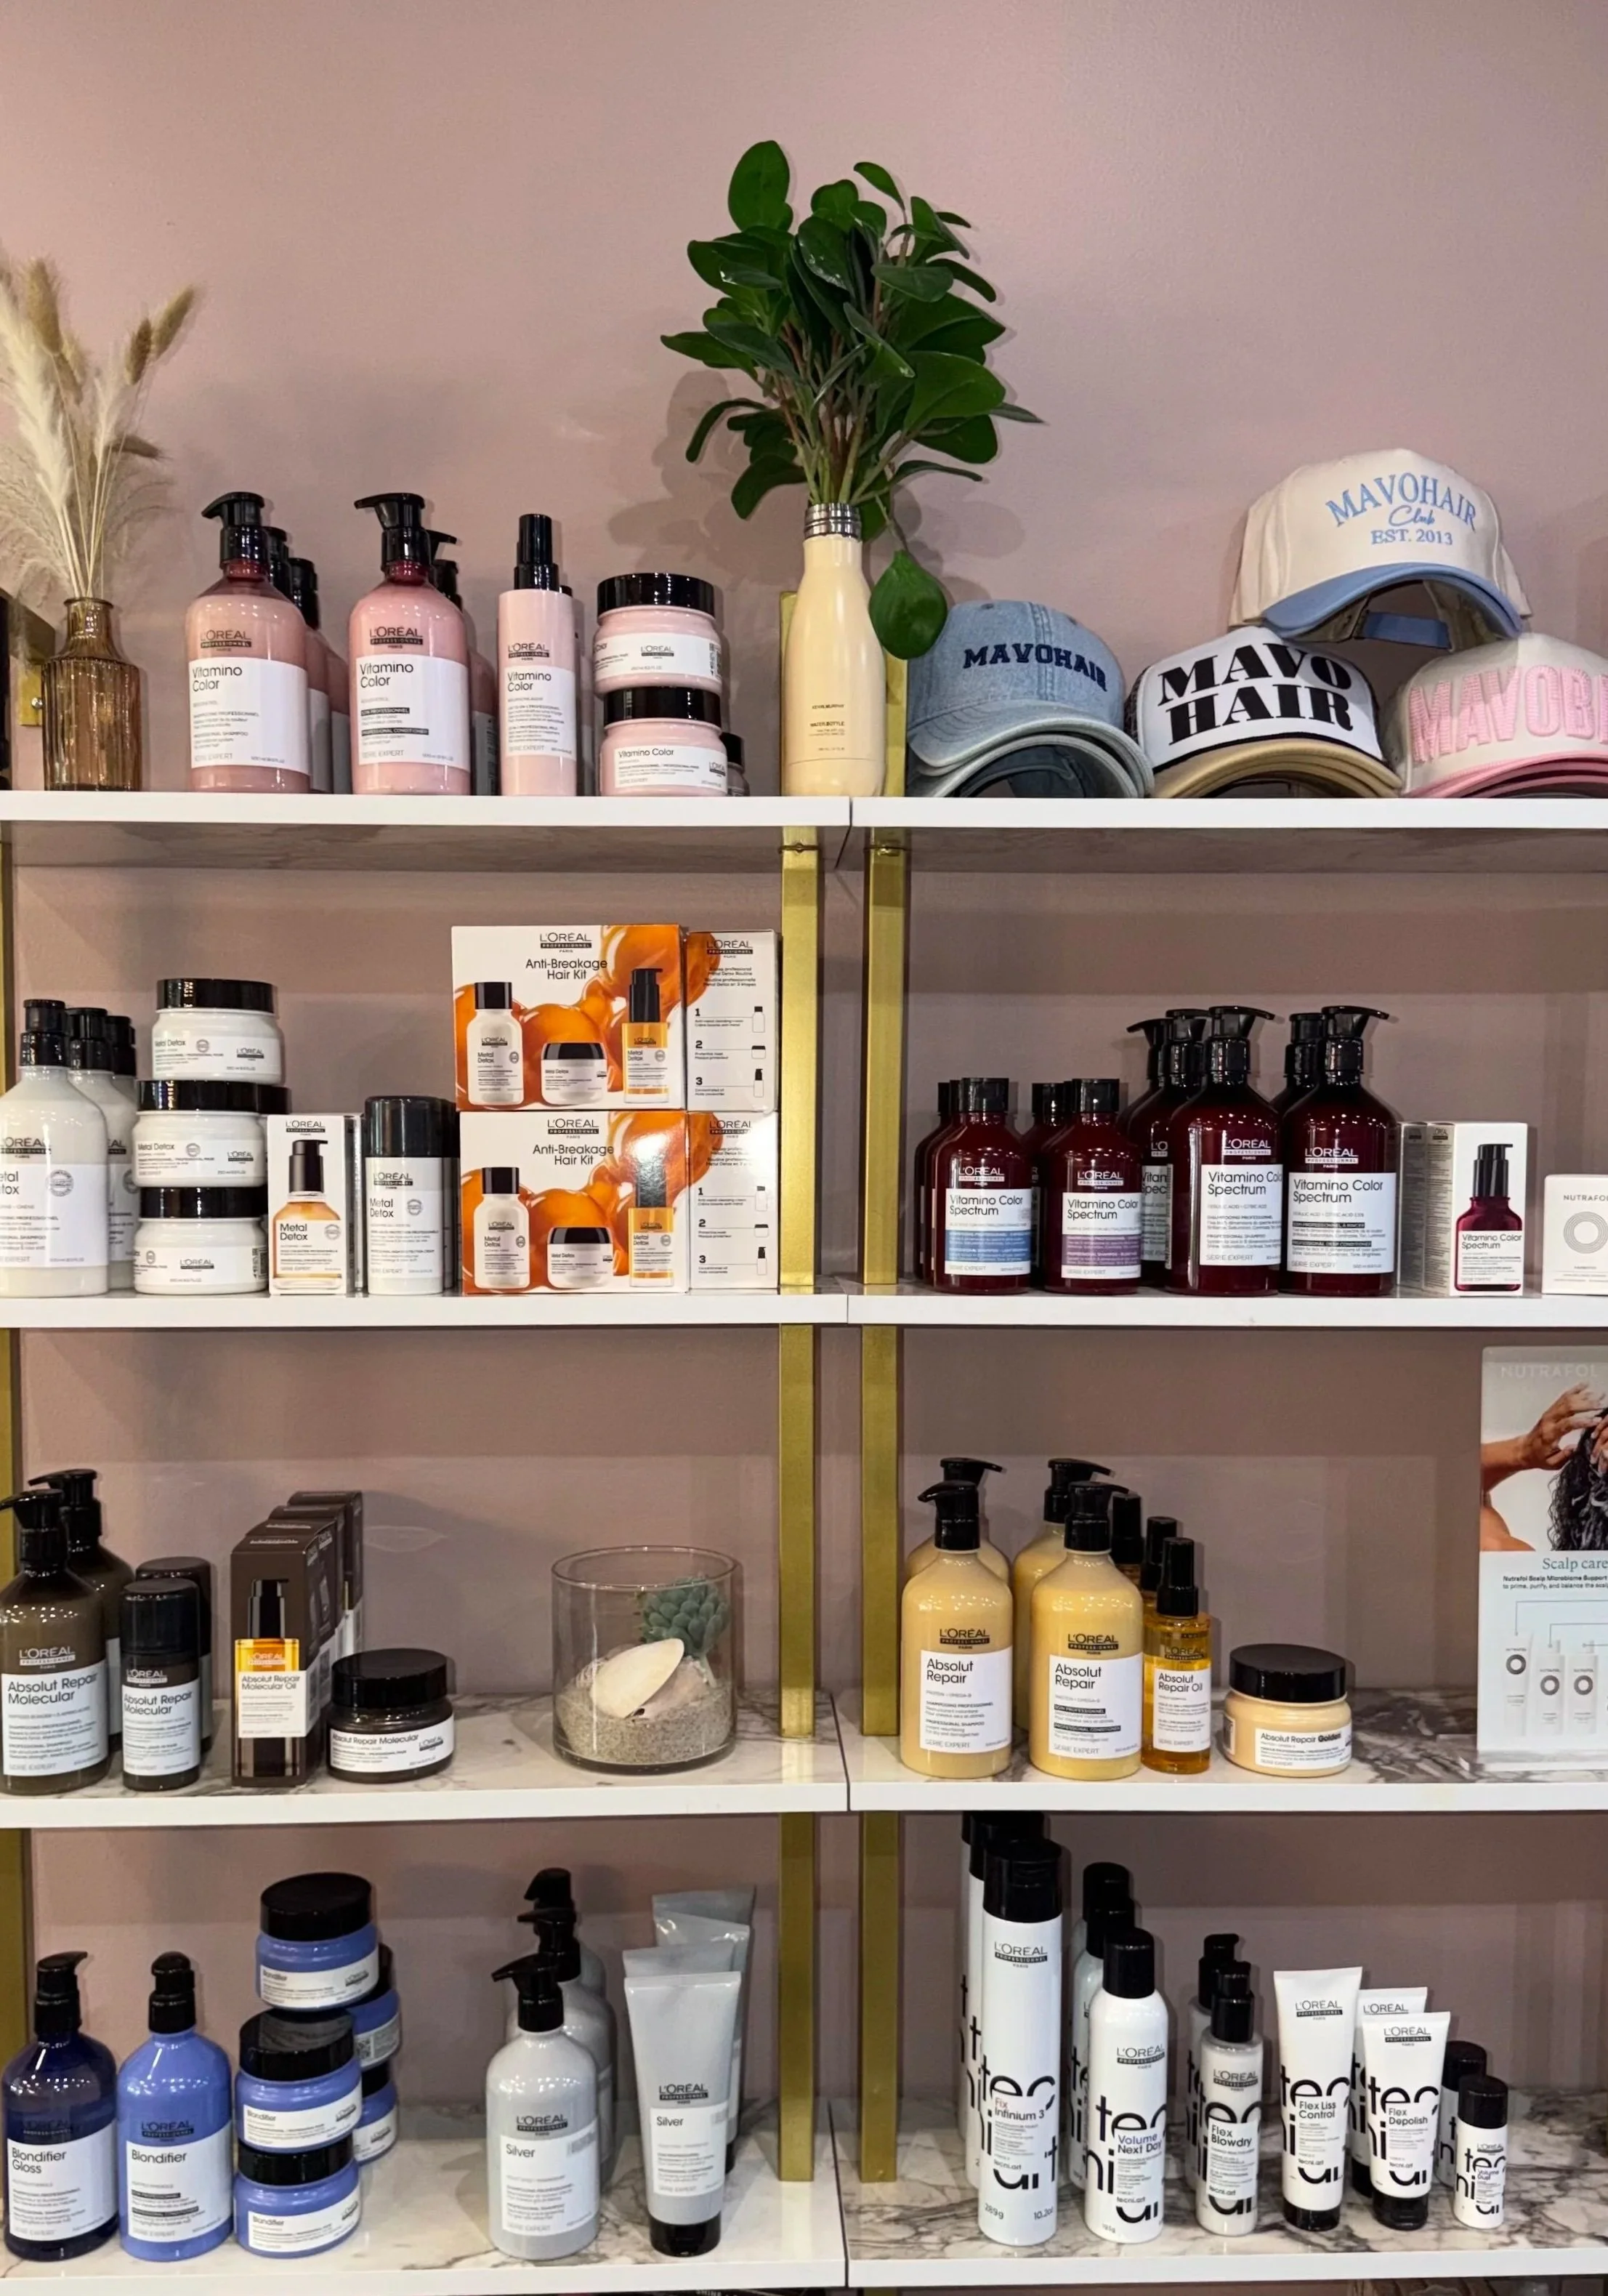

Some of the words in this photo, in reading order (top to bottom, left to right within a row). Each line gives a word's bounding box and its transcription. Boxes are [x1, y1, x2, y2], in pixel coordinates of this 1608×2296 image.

[1325, 472, 1477, 533] MAVOHAIR
[1389, 505, 1436, 526] Club
[1370, 529, 1413, 545] EST.
[1416, 528, 1453, 546] 2013
[193, 664, 243, 678] Vitamino
[360, 663, 413, 675] Vitamino
[963, 643, 1107, 692] MAVOHAIR
[507, 671, 552, 682] Vitamino
[1157, 643, 1352, 706] MAVO
[193, 680, 219, 692] Color
[360, 676, 391, 688] Color
[507, 682, 533, 692] Color
[1165, 684, 1354, 746] HAIR
[1409, 664, 1608, 765] MAVOB
[618, 749, 650, 758] Vitamino
[652, 748, 674, 757] Color
[540, 932, 591, 942] L'ORÉAL
[706, 939, 754, 948] L'ORÉAL
[525, 958, 607, 971] Anti-Breakage
[546, 969, 570, 980] Hair
[573, 969, 586, 980] Kit
[695, 1040, 703, 1049] 2
[547, 1119, 599, 1128] L'ORÉAL
[533, 1144, 614, 1154] Anti-Breakage
[1224, 1138, 1271, 1148] L'ORÉAL
[554, 1155, 577, 1165] Hair
[580, 1155, 594, 1165] Kit
[1078, 1170, 1123, 1180] L'ORÉAL
[1208, 1171, 1264, 1183] Vitamino
[1207, 1183, 1266, 1197] Spectrum
[1293, 1179, 1349, 1191] Vitamino
[1352, 1180, 1383, 1191] Color
[698, 1187, 703, 1196] 1
[1293, 1191, 1352, 1204] Spectrum
[370, 1198, 393, 1208] Metal
[950, 1195, 996, 1206] Vitamino
[998, 1195, 1023, 1206] Color
[1067, 1199, 1115, 1209] Vitamino
[1118, 1199, 1138, 1209] Color
[370, 1208, 394, 1218] Detox
[950, 1205, 999, 1218] Spectrum
[1067, 1209, 1118, 1221] Spectrum
[280, 1223, 307, 1232] Metal
[698, 1219, 706, 1228] 2
[280, 1232, 308, 1241] Detox
[1461, 1241, 1500, 1249] Spectrum
[1501, 1363, 1599, 1379] NUTRAFOL
[1543, 1557, 1578, 1572] Scalp
[1581, 1560, 1608, 1569] care
[940, 1628, 990, 1638] L'ORÉAL
[1068, 1633, 1118, 1643] L'ORÉAL
[926, 1658, 974, 1672] Absolut
[1055, 1663, 1102, 1678] Absolut
[8, 1680, 57, 1693] Absolut
[62, 1673, 97, 1689] Repair
[274, 1675, 300, 1684] Repair
[926, 1670, 967, 1685] Repair
[1055, 1675, 1096, 1690] Repair
[1158, 1672, 1194, 1683] Absolut
[1158, 1683, 1189, 1693] Repair
[1192, 1683, 1203, 1692] Oil
[8, 1691, 76, 1704] Molecular
[124, 1695, 158, 1706] Absolut
[161, 1691, 193, 1704] Repair
[124, 1704, 173, 1715] Molecular
[353, 1737, 377, 1746] Repair
[379, 1733, 419, 1745] Molecular
[1261, 1732, 1290, 1743] Absolut
[1291, 1735, 1316, 1744] Repair
[995, 1951, 1048, 1963] PROFESSIONNEL
[659, 2083, 708, 2094] L'ORÉAL
[995, 2097, 1009, 2108] Fix
[1299, 2100, 1320, 2110] Flex
[1321, 2101, 1337, 2110] Liss
[995, 2107, 1036, 2122] Infinium
[1038, 2109, 1045, 2119] 3
[1298, 2110, 1336, 2119] Control
[1389, 2107, 1407, 2116] Flex
[656, 2116, 684, 2127] Silver
[1389, 2116, 1429, 2127] Depolish
[1211, 2124, 1232, 2138] Flex
[1118, 2133, 1157, 2145] Volume
[1211, 2133, 1253, 2148] Blowdry
[506, 2143, 536, 2158] Silver
[1118, 2145, 1143, 2154] Next
[1146, 2140, 1162, 2153] Day
[12, 2147, 67, 2162] Blondifier
[132, 2148, 187, 2164] Blondifier
[12, 2159, 42, 2173] Gloss
